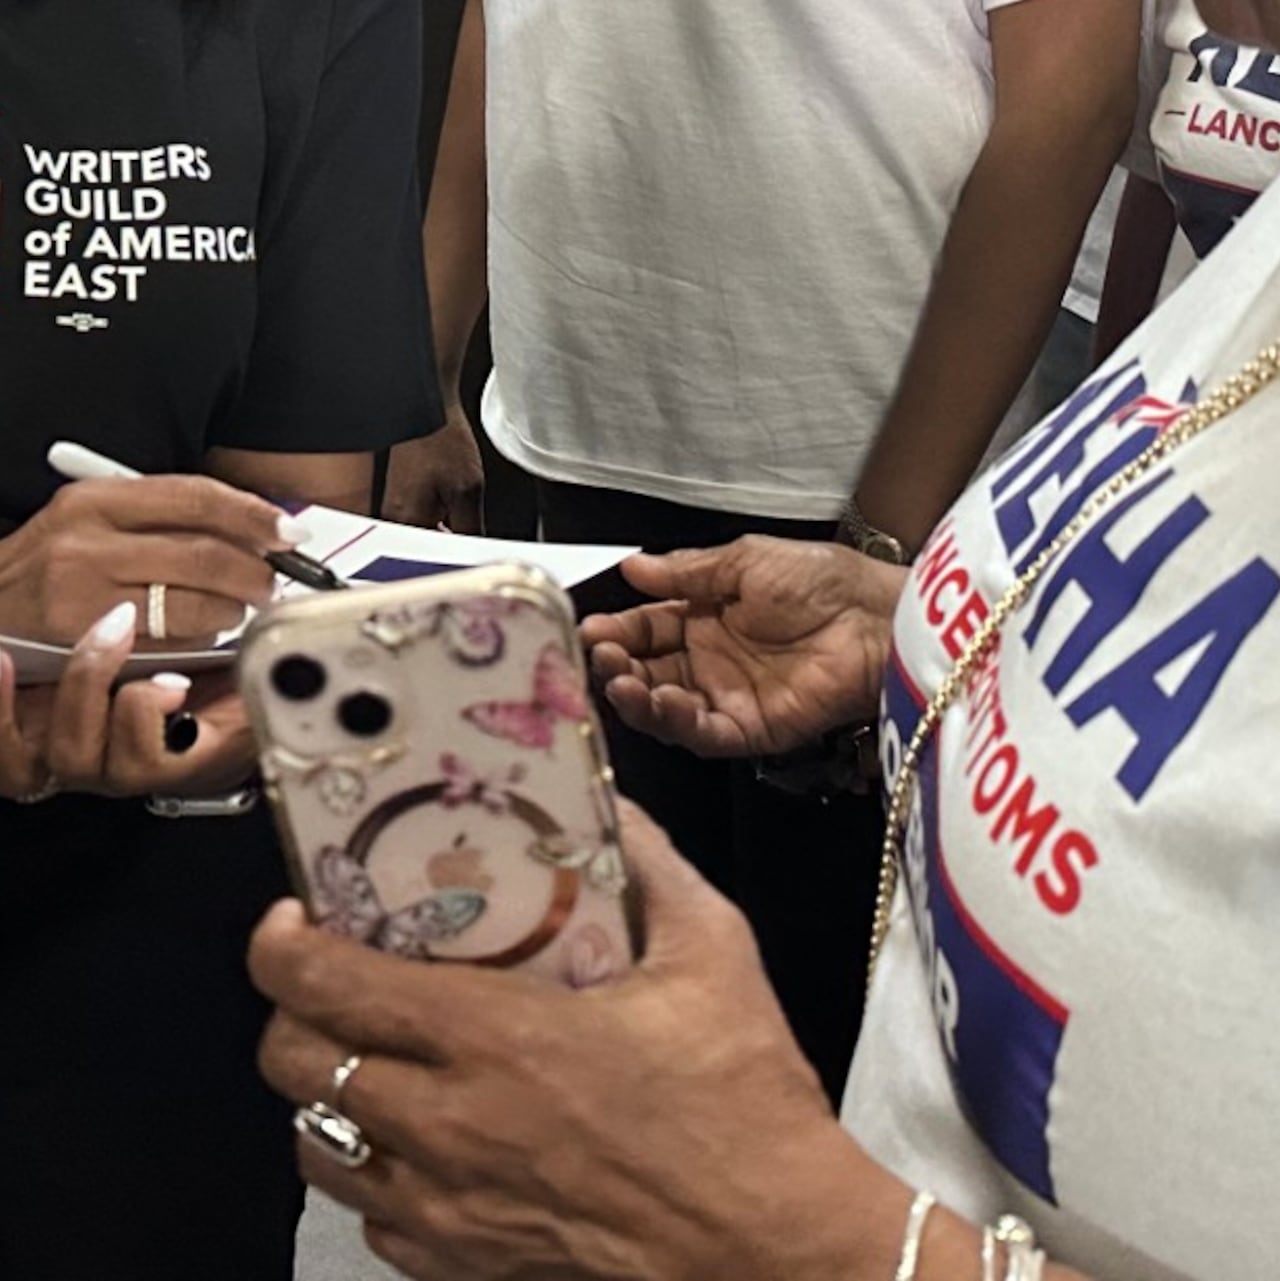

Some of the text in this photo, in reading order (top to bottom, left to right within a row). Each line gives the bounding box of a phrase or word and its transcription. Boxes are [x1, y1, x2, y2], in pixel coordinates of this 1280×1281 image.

[23, 143, 212, 183] WRITERS
[24, 178, 168, 222] GUILD
[24, 221, 72, 258] of
[23, 260, 147, 302] EAST
